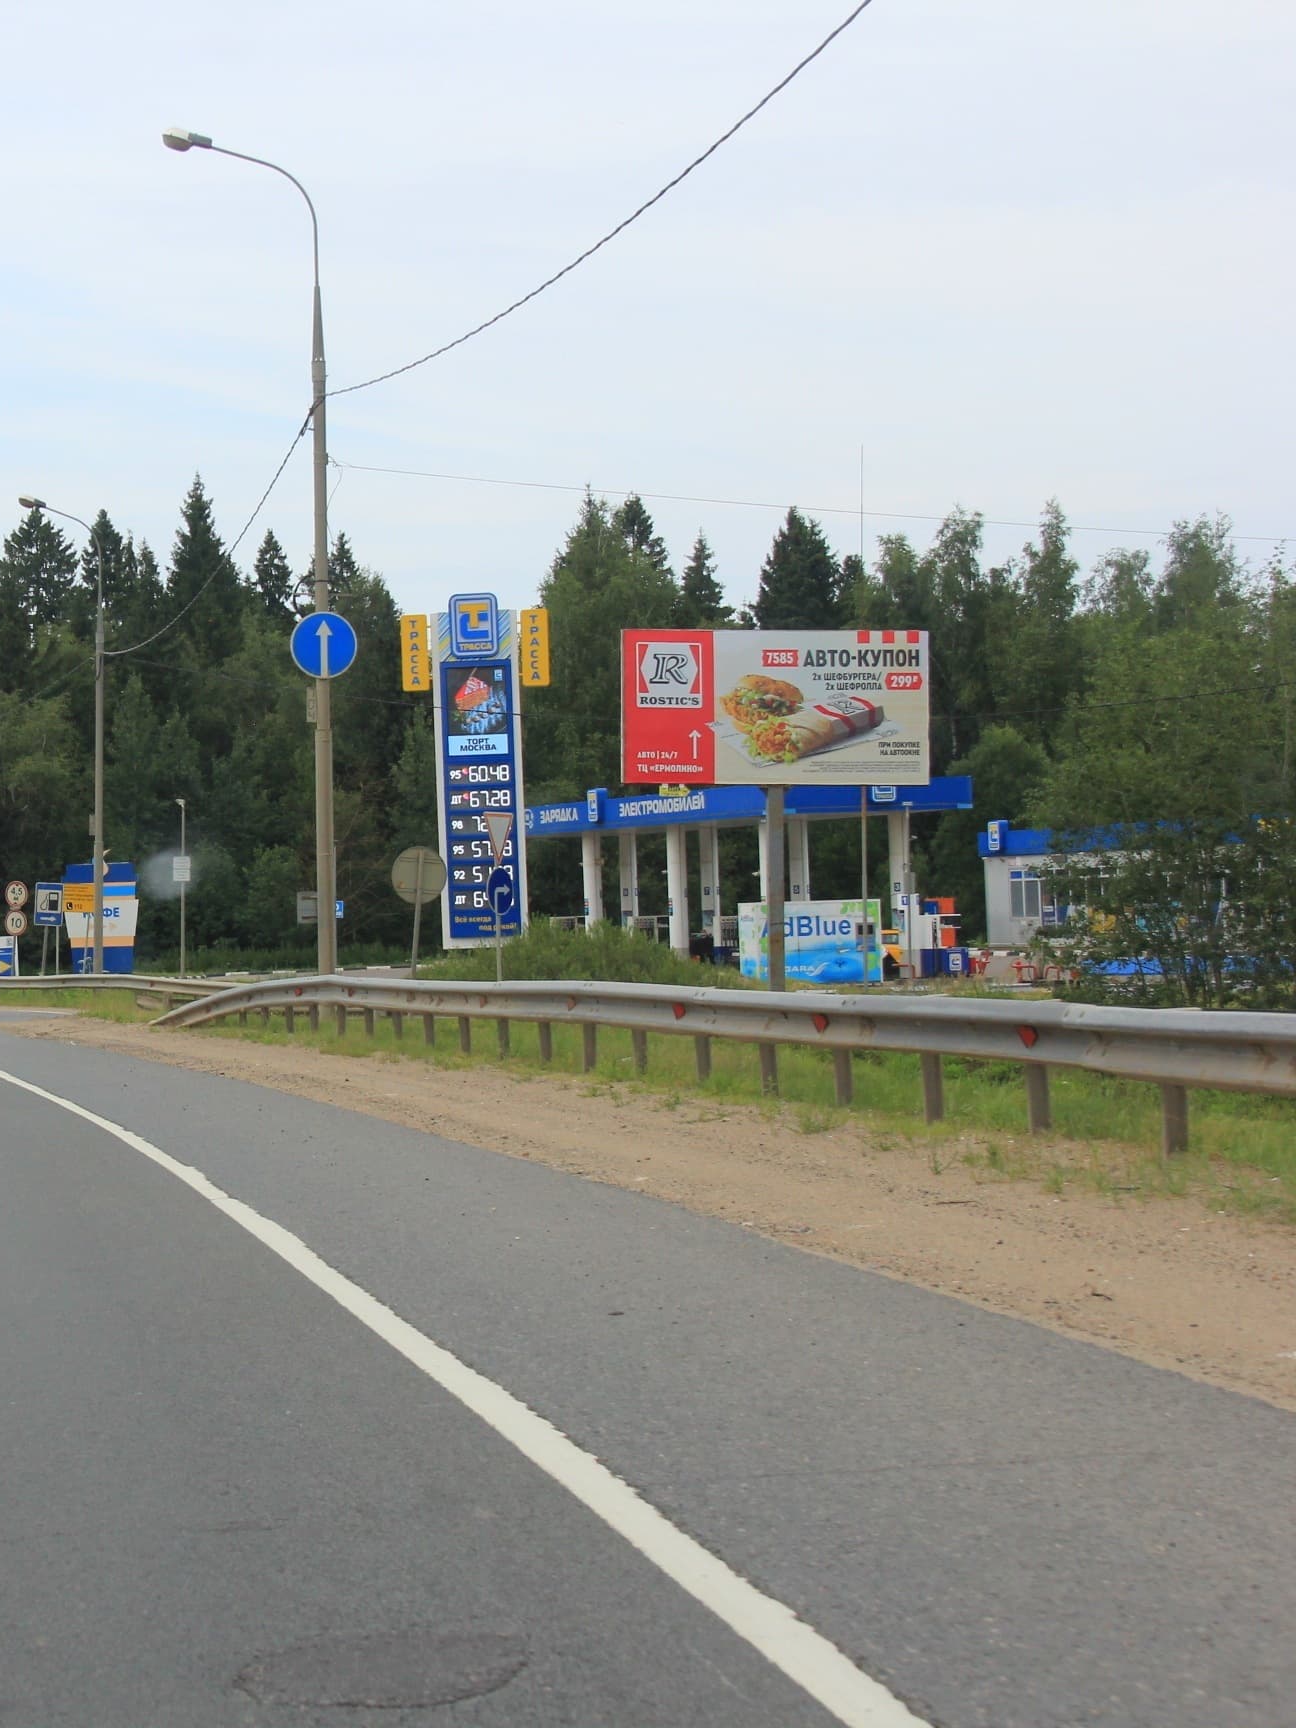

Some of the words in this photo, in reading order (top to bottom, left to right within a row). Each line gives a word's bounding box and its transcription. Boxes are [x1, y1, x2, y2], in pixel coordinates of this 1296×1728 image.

[409, 620, 421, 685] ТРАССА
[529, 615, 541, 680] ТРАССА
[766, 652, 793, 664] 7585
[803, 649, 920, 667] АВТО-КУПОН
[836, 682, 882, 691] ШЕФРОЛЛА
[640, 696, 700, 706] ROSTIC'S
[467, 737, 490, 745] ТОРТ
[460, 744, 497, 752] МОСКВА
[637, 751, 656, 759] АВТО
[660, 751, 678, 760] 24/7
[449, 770, 462, 780] 95
[468, 764, 510, 782] 60.48
[637, 764, 648, 773] ТЦ
[450, 795, 463, 805] ДТ
[469, 790, 511, 807] 67.28
[618, 792, 705, 818] ЭЛЕКТРОМОБИЛЕЙ
[539, 807, 579, 824] ЗАРЯДКА
[451, 820, 464, 830] 98
[452, 845, 464, 855] 95
[453, 870, 466, 880] 92
[11, 918, 22, 929] 10
